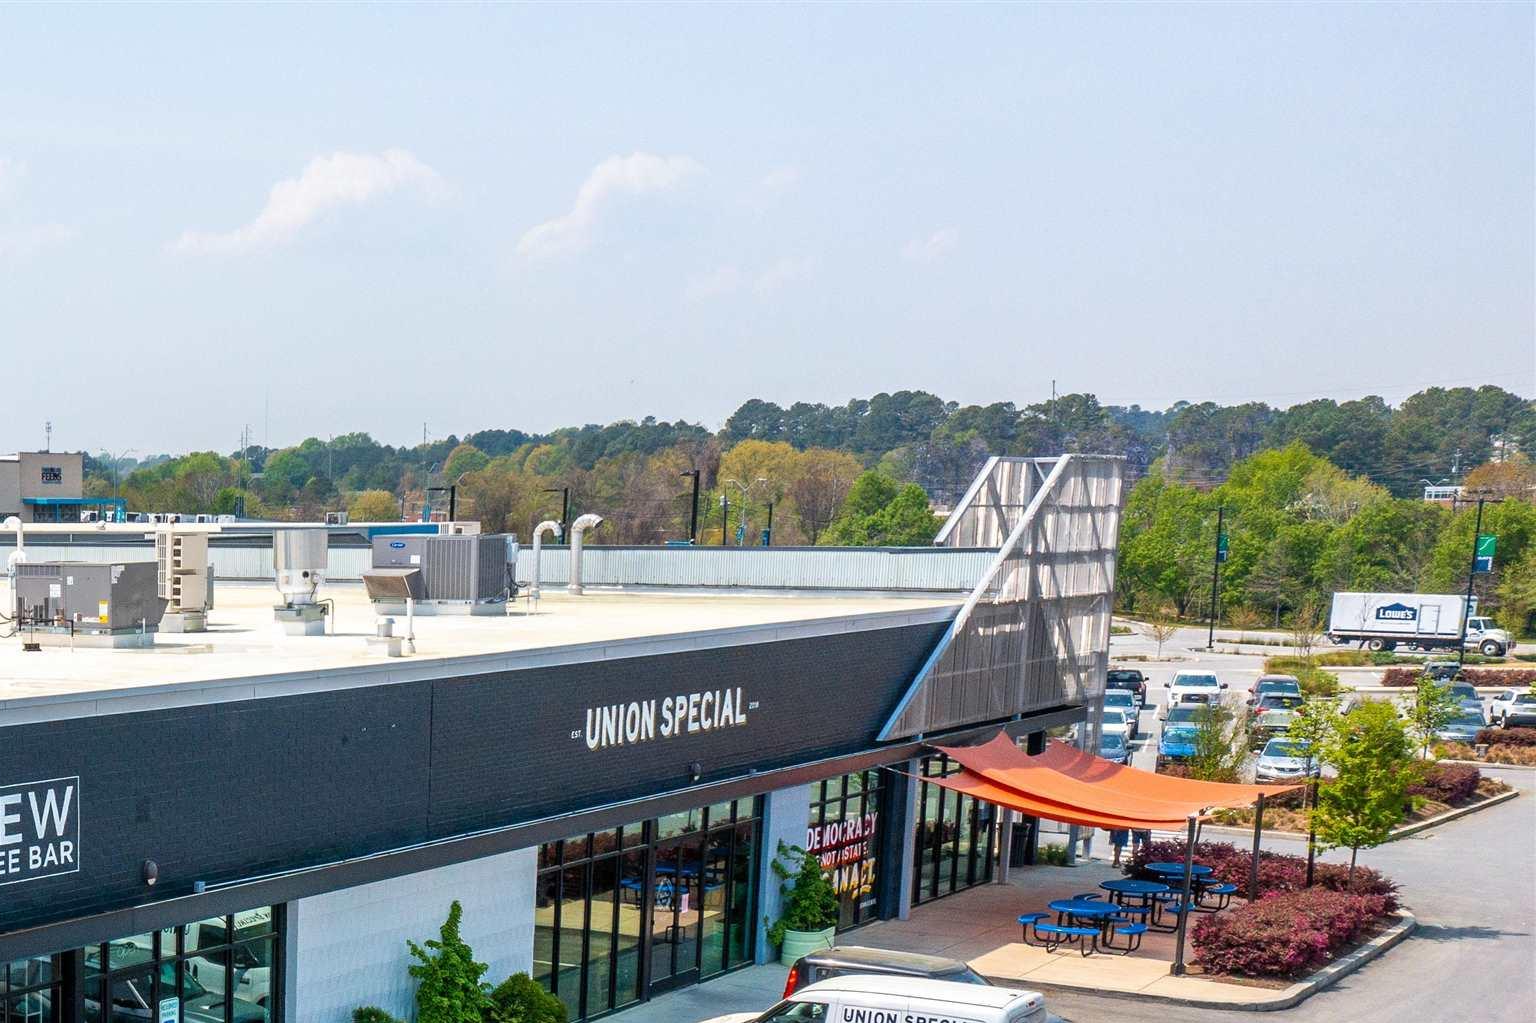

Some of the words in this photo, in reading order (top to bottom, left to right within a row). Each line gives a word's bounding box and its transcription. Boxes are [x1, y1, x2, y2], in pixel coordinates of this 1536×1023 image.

[1379, 608, 1414, 619] LOWE'S
[585, 699, 657, 750] UNION
[659, 687, 748, 737] SPECIAL
[806, 812, 878, 852] DEMOCRACY
[28, 841, 74, 870] BAR
